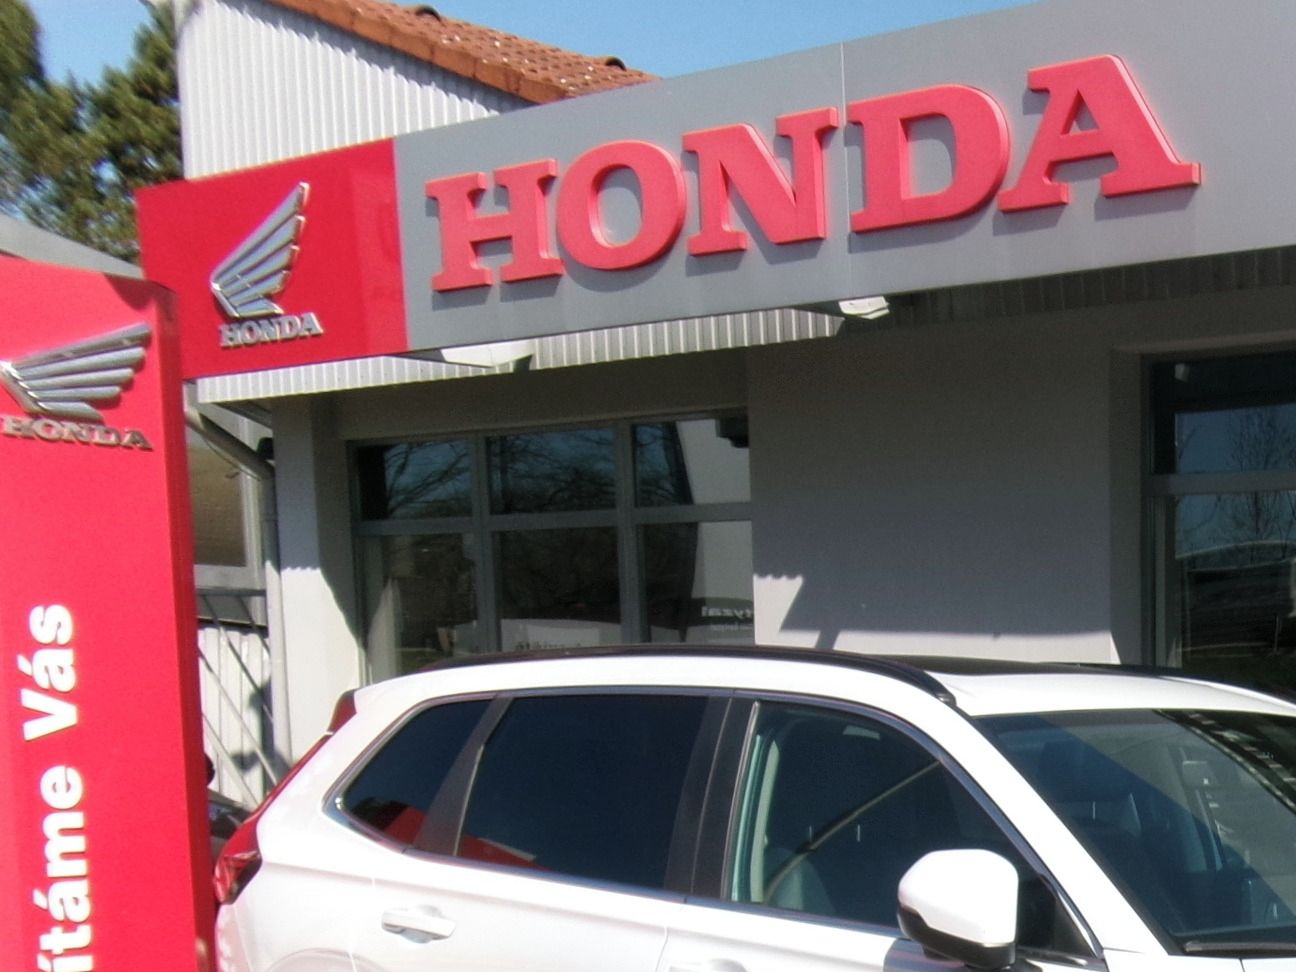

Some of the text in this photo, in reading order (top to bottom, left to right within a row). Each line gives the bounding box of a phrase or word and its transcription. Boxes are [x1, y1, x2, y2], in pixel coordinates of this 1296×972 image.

[425, 54, 1201, 292] HONDA
[218, 312, 323, 348] HONDA
[0, 413, 153, 450] HONDA
[17, 604, 78, 741] Vás
